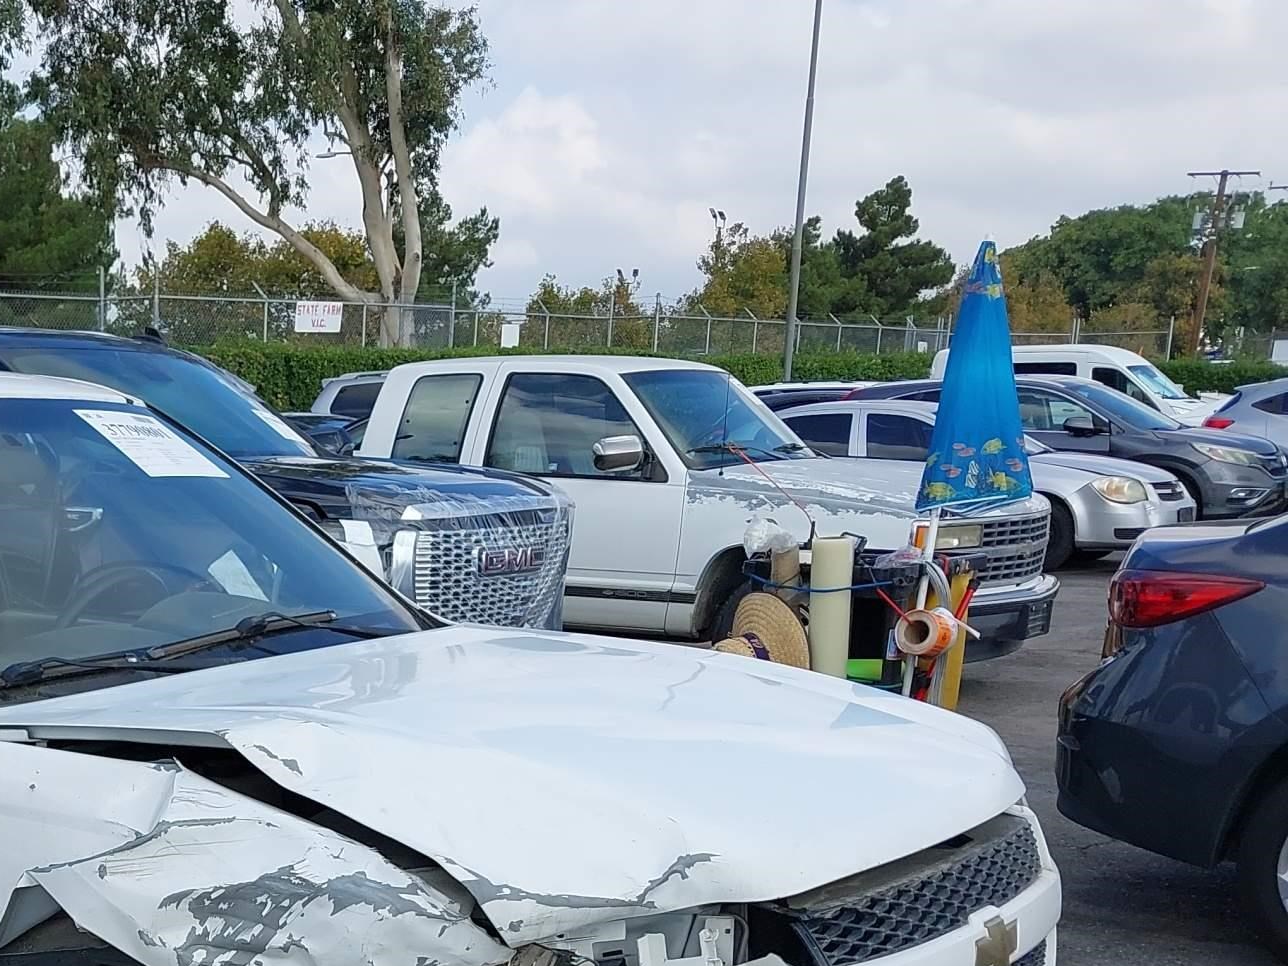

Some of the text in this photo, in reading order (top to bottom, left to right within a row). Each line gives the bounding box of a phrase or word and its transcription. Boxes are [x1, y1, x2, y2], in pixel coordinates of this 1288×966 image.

[297, 304, 342, 316] STATE FARM
[481, 546, 546, 573] GMC
